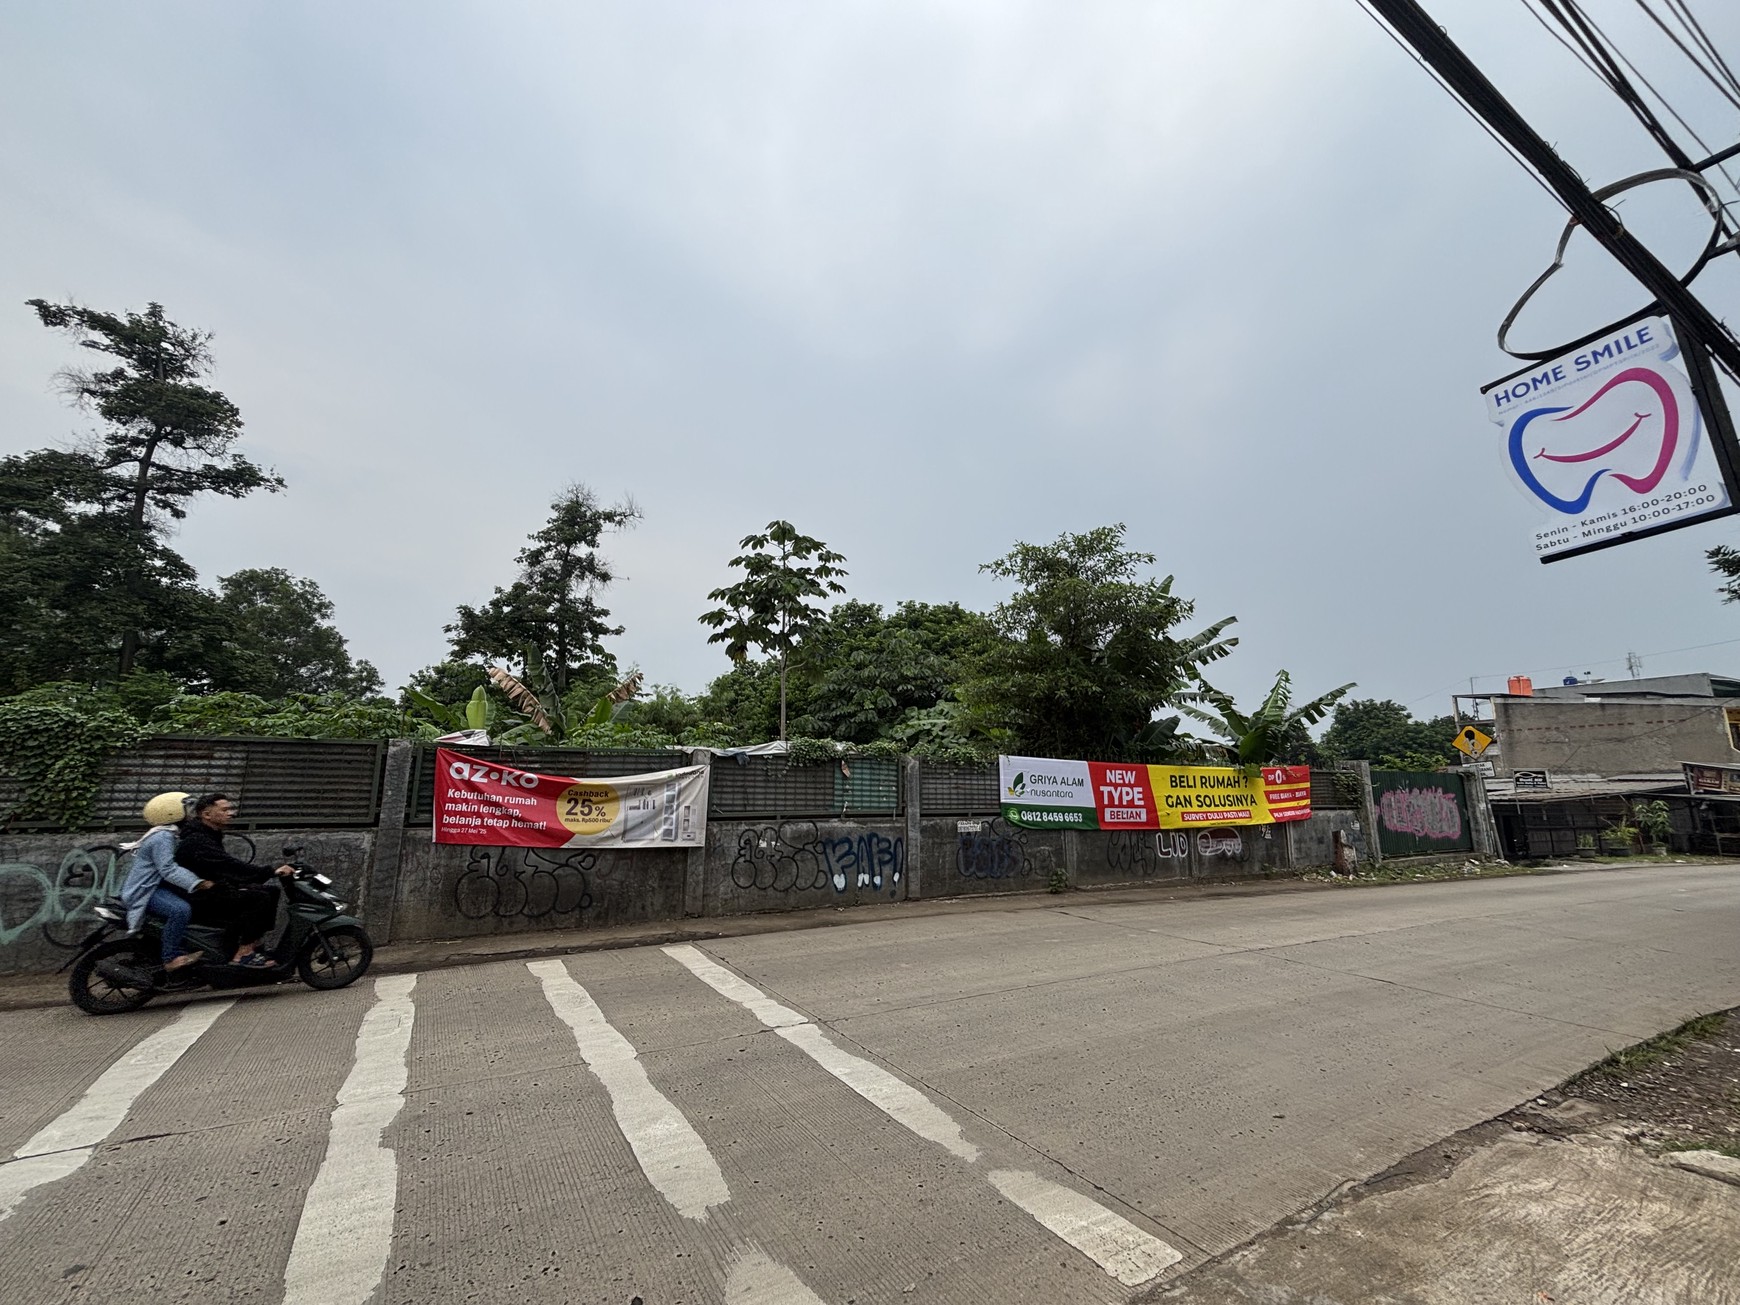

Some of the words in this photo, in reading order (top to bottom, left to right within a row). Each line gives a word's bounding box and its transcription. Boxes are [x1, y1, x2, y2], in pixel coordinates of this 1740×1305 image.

[1495, 365, 1566, 407] HOME
[1574, 326, 1653, 372] SMILE
[1535, 526, 1569, 541] Senin
[1580, 511, 1618, 528] Kamis
[1621, 484, 1708, 516] 16:00-20:00
[1535, 536, 1570, 551] Sabtu
[1581, 520, 1628, 538] Minggu
[1630, 494, 1716, 525] 10:00-17:00
[1029, 774, 1058, 786] GRIYA
[1060, 777, 1084, 787] ALAM
[1106, 769, 1136, 784] NEW
[1169, 774, 1197, 789] BELI
[1200, 775, 1241, 789] RUMAH
[1242, 775, 1248, 789] ?
[447, 788, 502, 803] Kebutuhan
[504, 796, 537, 806] rumah
[567, 789, 609, 798] Cashback
[1030, 788, 1074, 799] nusantara
[1100, 785, 1145, 806] TYPE
[1165, 795, 1193, 808] GAN
[1196, 793, 1258, 808] SOLUSINYA
[444, 802, 478, 813] makin
[480, 804, 522, 818] lengkap,
[565, 797, 606, 817] 25%
[442, 814, 482, 827] belanja
[483, 817, 509, 828] tetap
[511, 818, 547, 831] hemat!
[1020, 810, 1041, 822] 0812
[1042, 811, 1064, 822] 8459
[1064, 812, 1083, 823] 6653
[1109, 810, 1142, 821] BELIAN
[1183, 812, 1207, 821] SURVEY
[1207, 812, 1223, 820] DULU
